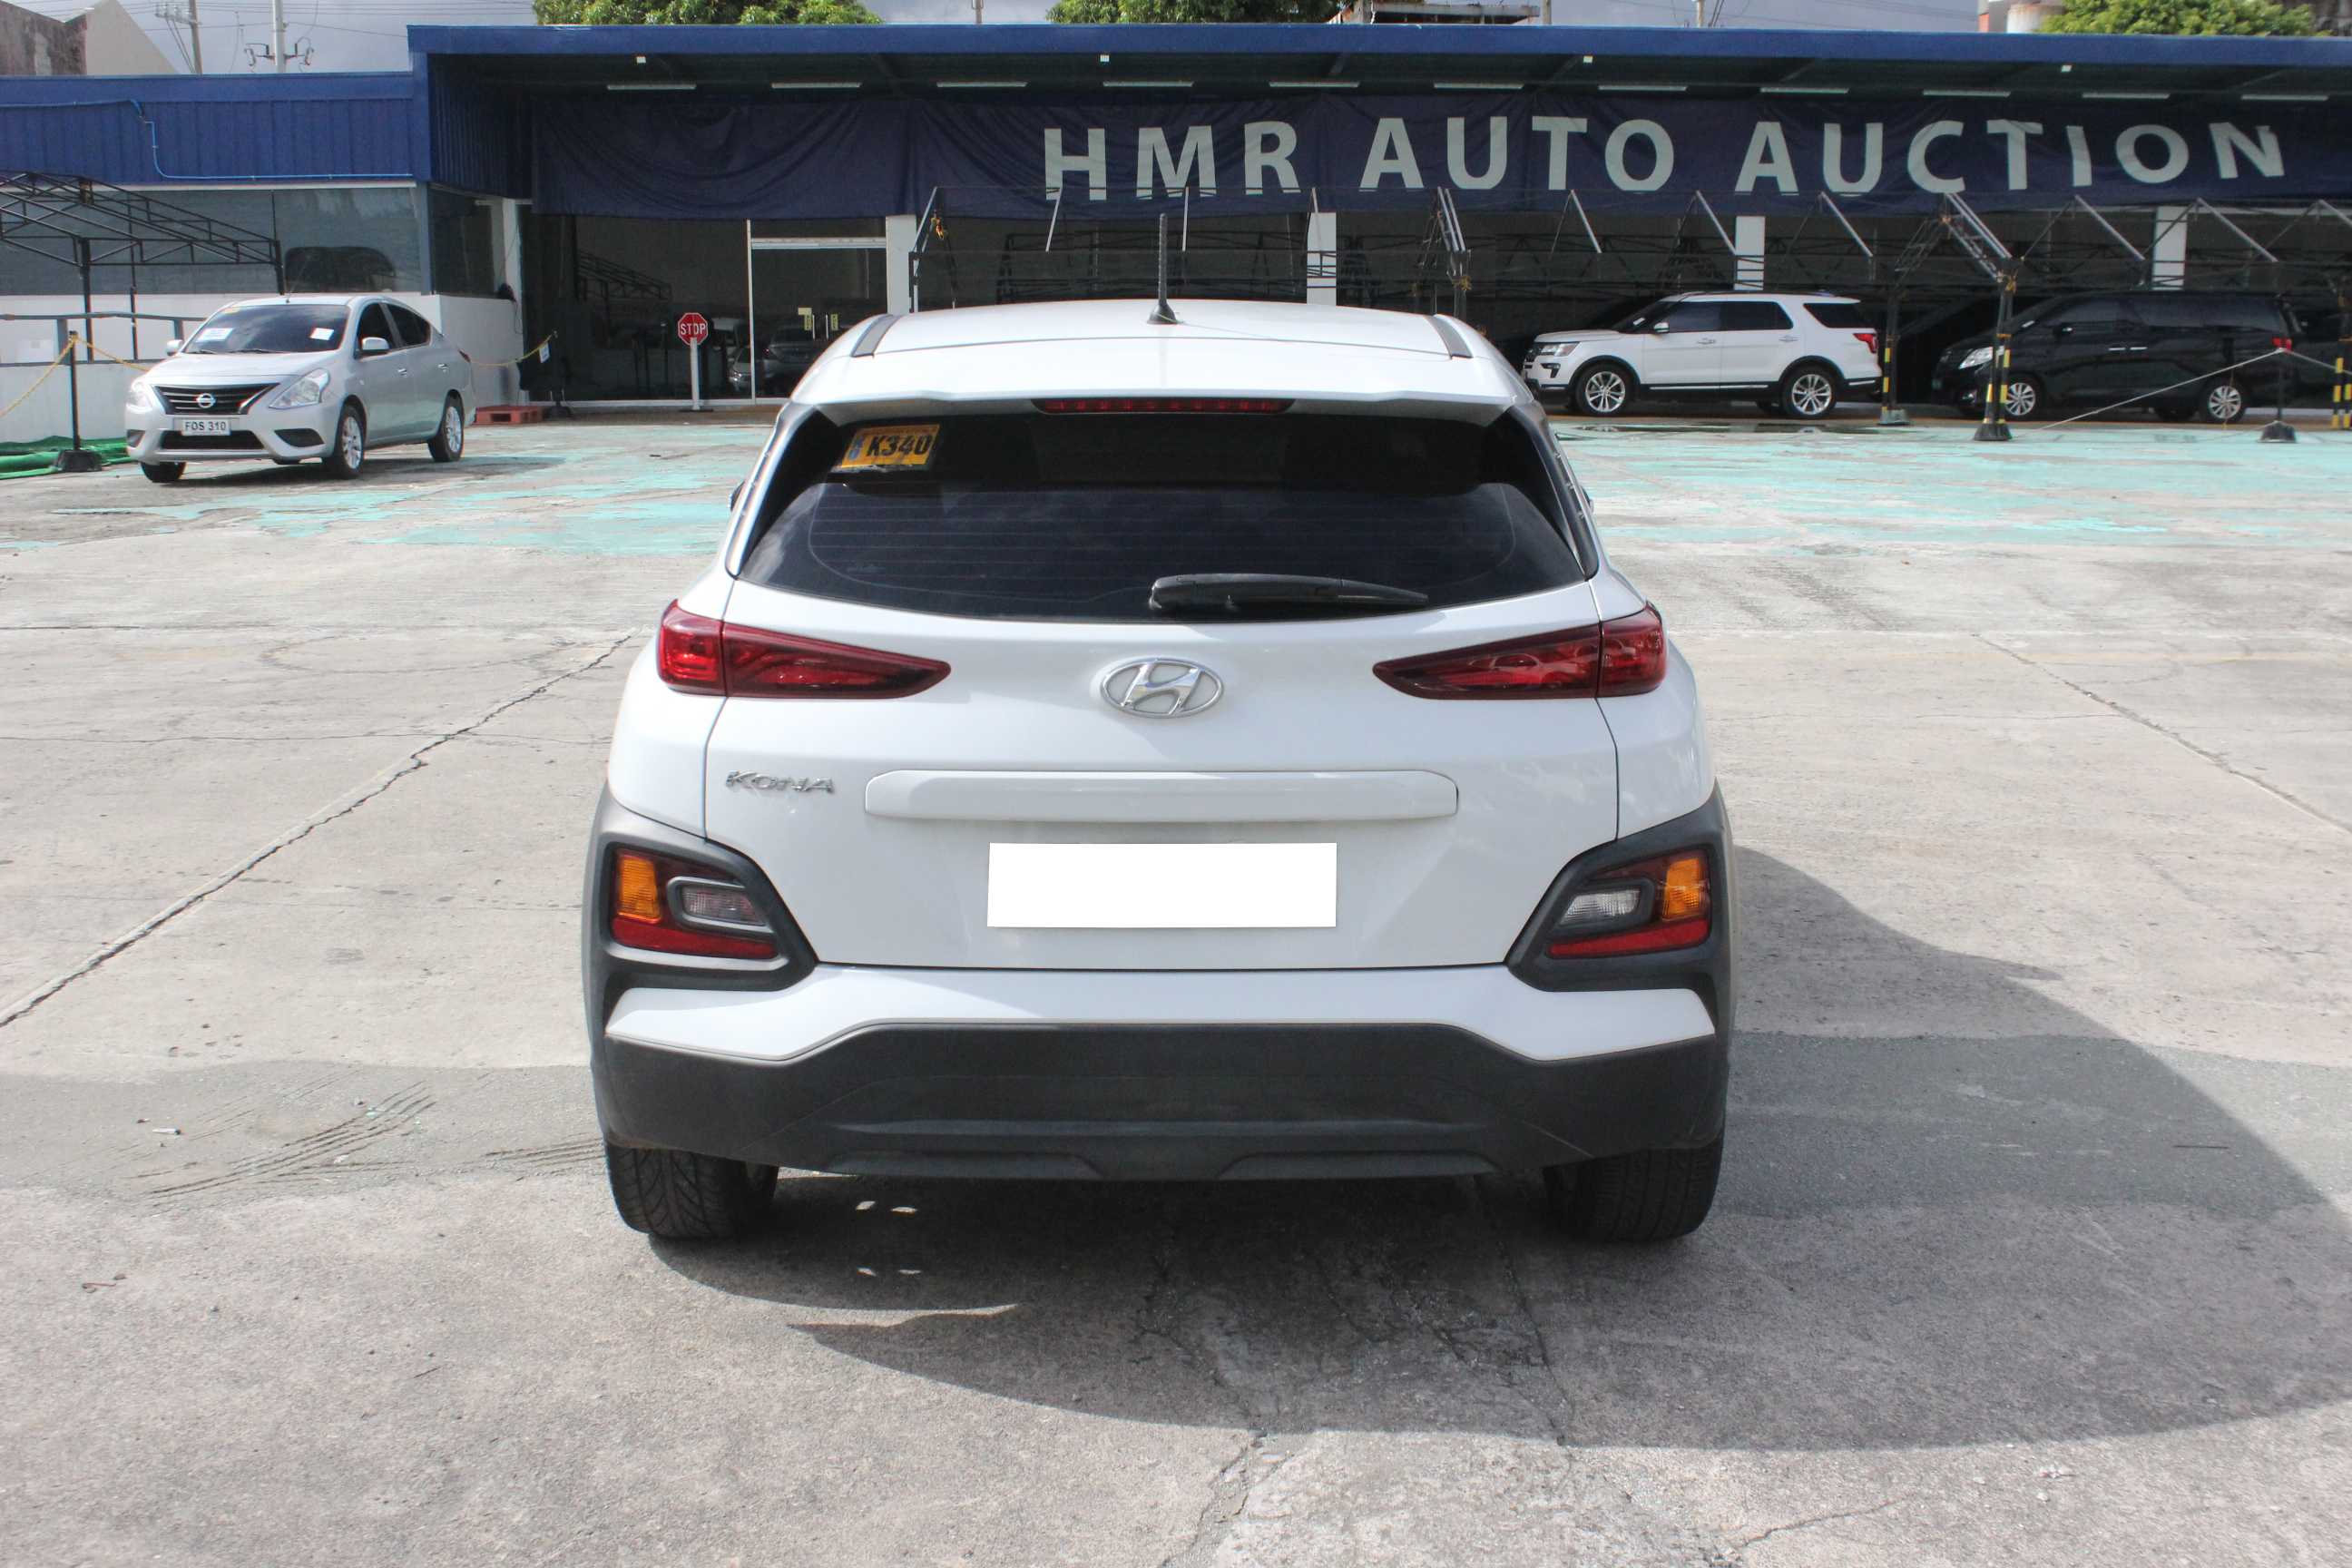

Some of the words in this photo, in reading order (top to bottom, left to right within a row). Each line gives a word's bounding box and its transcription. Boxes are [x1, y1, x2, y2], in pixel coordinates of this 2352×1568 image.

[1044, 120, 1301, 201] HMR
[1358, 116, 1675, 194] AUTO
[1734, 119, 2286, 197] AUCTION
[681, 323, 706, 335] STOP
[725, 769, 835, 793] KONA
